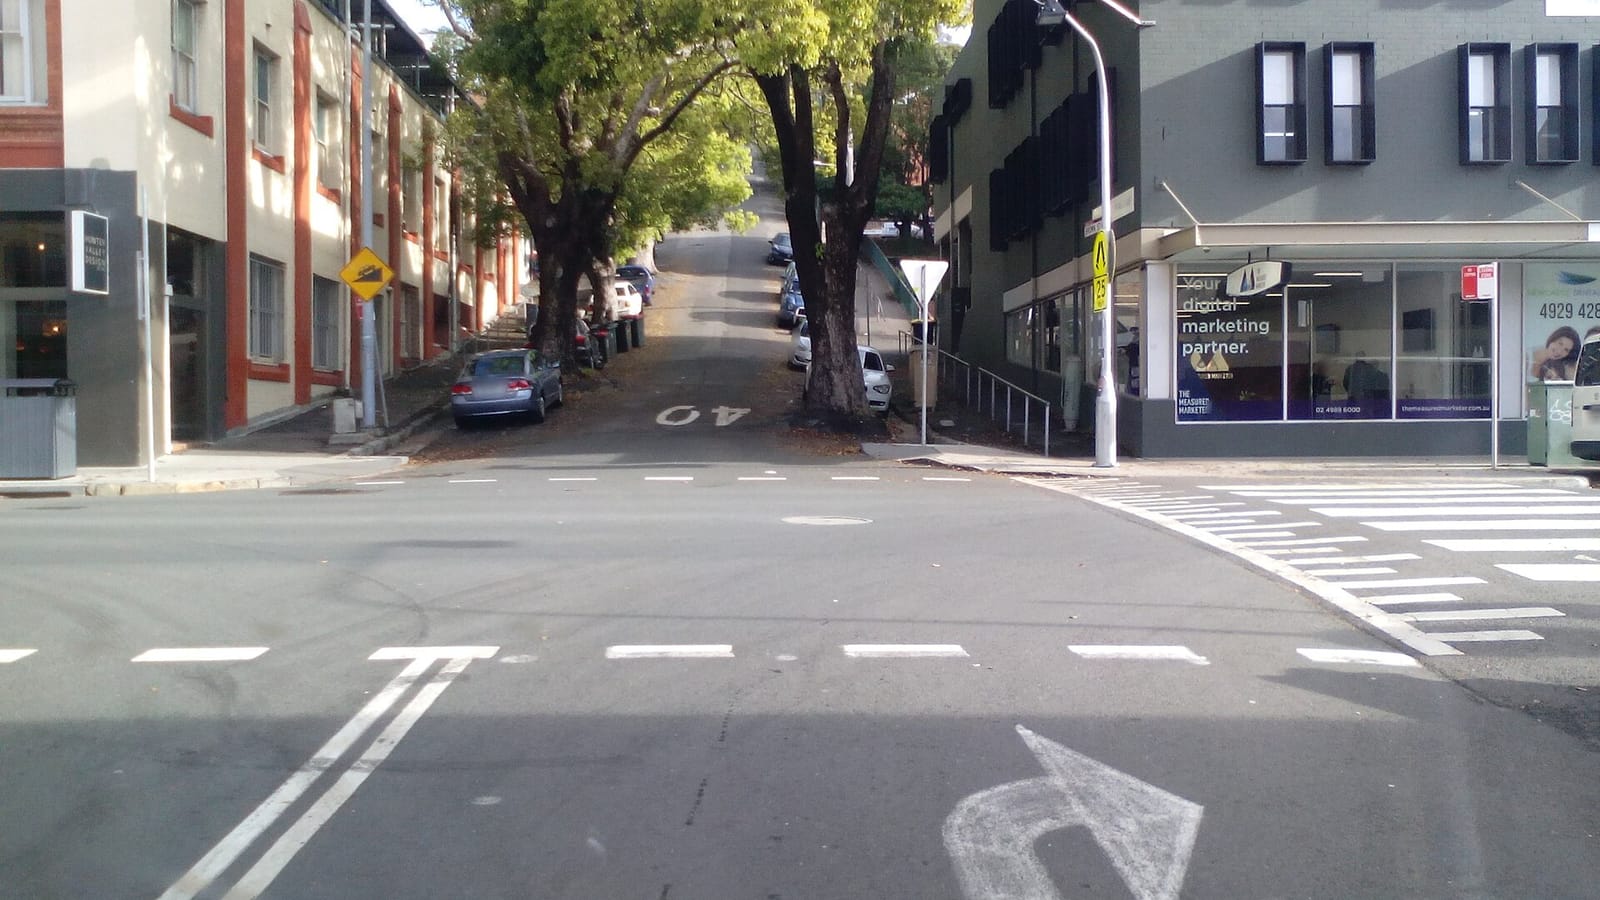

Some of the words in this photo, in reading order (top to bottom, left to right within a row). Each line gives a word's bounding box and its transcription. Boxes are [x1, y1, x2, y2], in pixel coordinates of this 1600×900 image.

[1096, 280, 1106, 299] 25
[1183, 277, 1221, 290] Your
[1183, 297, 1237, 314] digital
[1540, 303, 1573, 319] 4929
[1183, 318, 1270, 335] marketing
[1183, 341, 1249, 356] partner.
[1179, 390, 1190, 398] THE
[656, 405, 751, 426] 40
